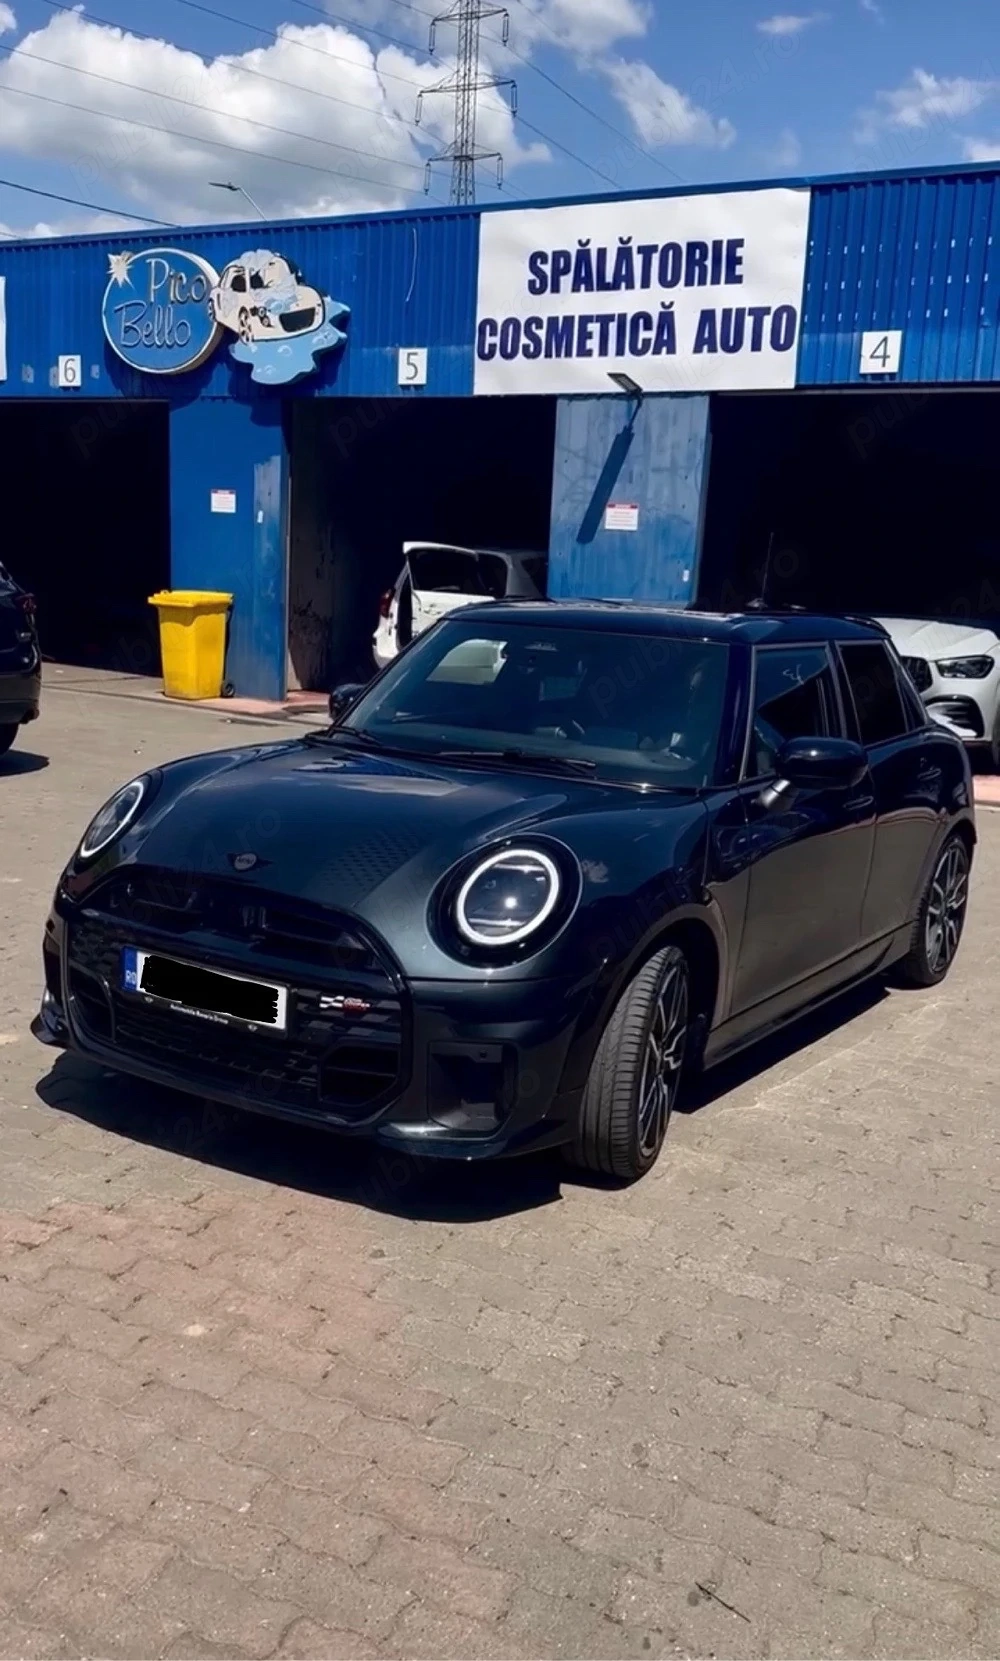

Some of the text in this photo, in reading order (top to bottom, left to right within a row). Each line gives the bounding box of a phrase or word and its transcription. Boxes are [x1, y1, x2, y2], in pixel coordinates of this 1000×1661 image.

[145, 257, 208, 305] Pico
[527, 236, 745, 296] SPĂLĂTORIE
[113, 299, 192, 348] Bello
[476, 300, 798, 362] COSMETICĂ AUTO
[63, 357, 76, 383] 6
[405, 351, 419, 381] 5
[869, 335, 891, 368] 4
